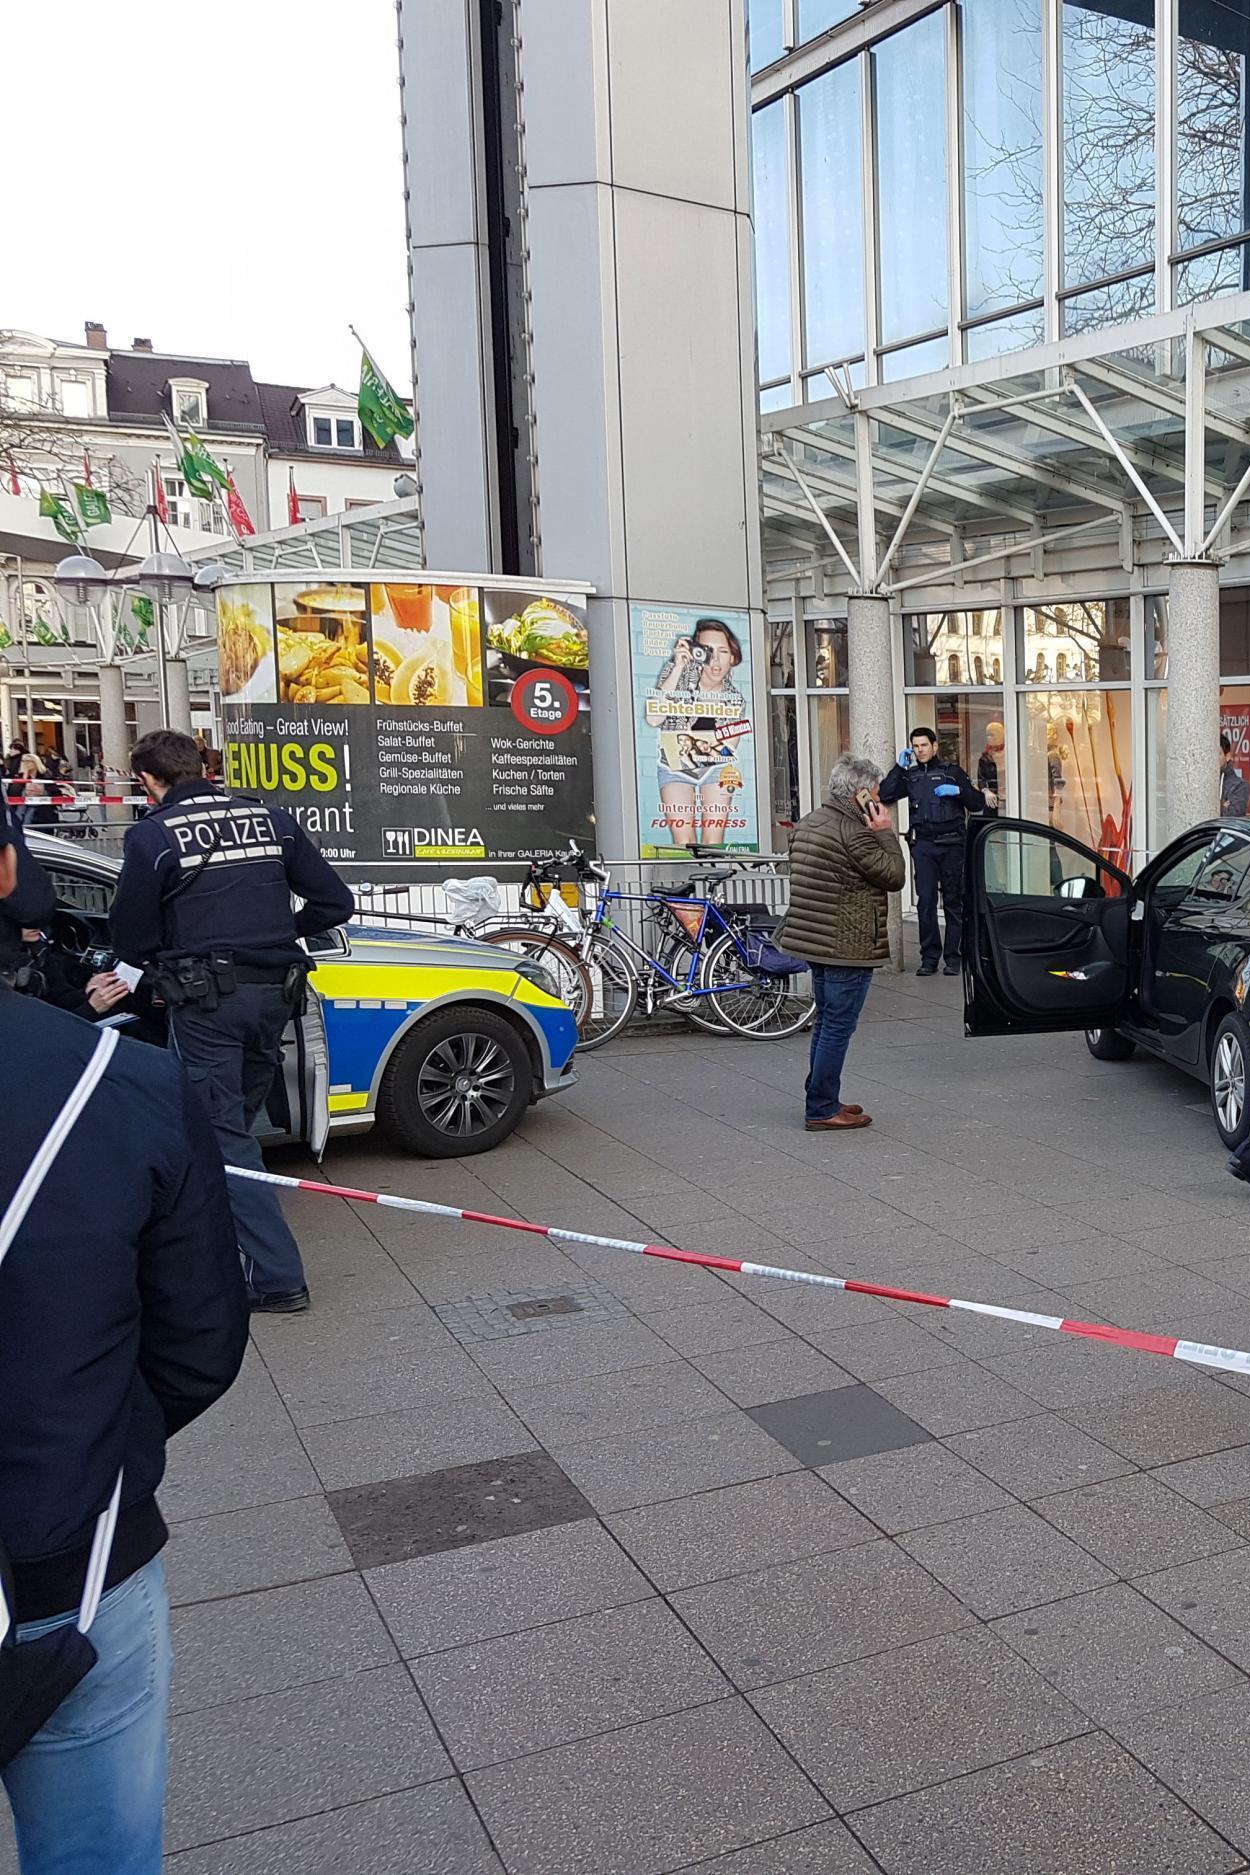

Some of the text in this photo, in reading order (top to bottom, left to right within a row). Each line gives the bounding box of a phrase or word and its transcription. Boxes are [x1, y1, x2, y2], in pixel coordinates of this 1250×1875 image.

[533, 682, 561, 708] 5.
[530, 708, 562, 720] Etage
[226, 719, 240, 736] ood
[240, 718, 264, 738] Eating
[276, 718, 309, 736] Great
[311, 718, 349, 736] View!
[376, 719, 464, 733] Frühstücks-Buffet
[377, 735, 435, 748] Salat-Buffet
[490, 738, 555, 750] Wok-Gerichte
[378, 751, 452, 764] Gemüse-Buffet
[491, 754, 578, 767] Kaffeespezialitäten
[379, 767, 464, 781] Grill-Spezialitäten
[492, 769, 528, 781] Kuchen
[537, 769, 565, 781] Torten
[380, 782, 461, 796] Regionale Küche
[493, 784, 554, 796] Frische Säfte
[493, 803, 507, 811] und
[508, 803, 527, 811] vieles
[527, 803, 545, 811] mehr
[658, 804, 739, 816] Untergeschoss
[651, 819, 747, 829] FOTO-EXPRESS
[174, 818, 277, 853] POLIZEI
[414, 828, 485, 846] DINEA
[340, 848, 356, 859] Uhr
[489, 850, 496, 858] in
[497, 850, 516, 858] Ihrer
[517, 850, 554, 858] GALERIA
